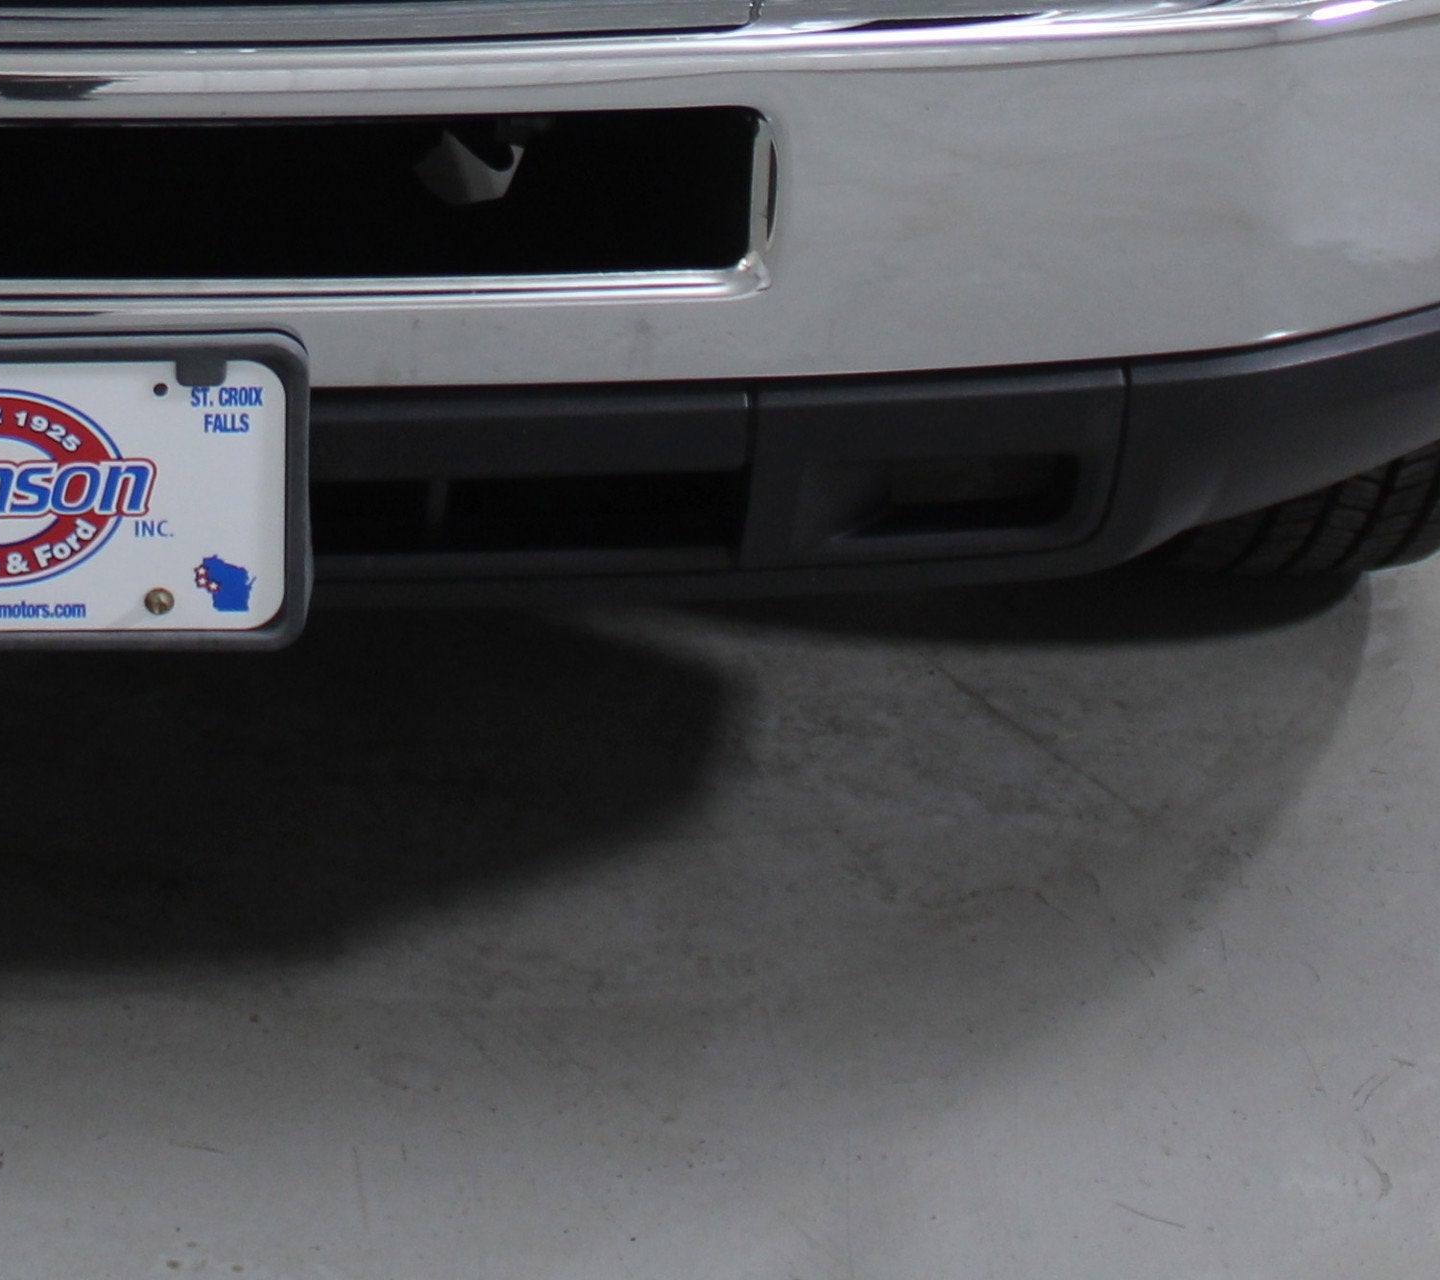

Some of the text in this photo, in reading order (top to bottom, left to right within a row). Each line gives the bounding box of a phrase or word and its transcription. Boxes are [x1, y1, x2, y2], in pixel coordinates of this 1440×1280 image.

[190, 386, 264, 407] ST. CROIX
[14, 410, 82, 453] 1925
[204, 412, 250, 433] FALLS
[133, 519, 175, 538] INC.
[6, 552, 30, 575] &
[32, 518, 98, 568] Ford
